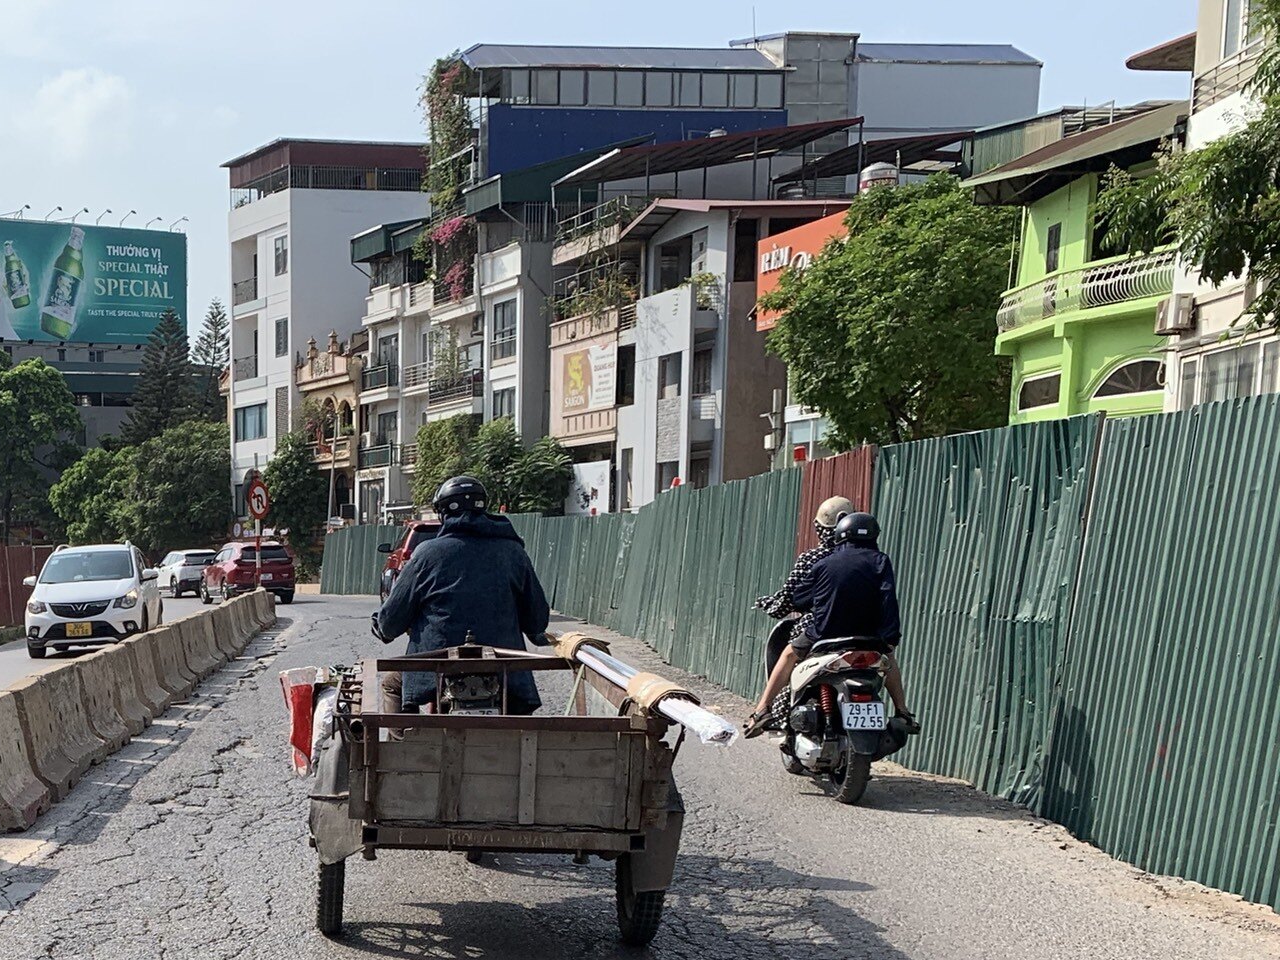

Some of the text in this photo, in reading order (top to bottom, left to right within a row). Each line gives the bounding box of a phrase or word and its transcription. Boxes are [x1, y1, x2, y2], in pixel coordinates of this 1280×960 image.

[151, 248, 161, 261] VỊ
[761, 243, 792, 273] RÈM
[99, 261, 169, 278] SPECIAL THẬT
[94, 278, 174, 299] SPECIAL
[88, 309, 104, 317] TASTE
[117, 310, 140, 318] SPECIAL
[141, 311, 158, 319] TRULY
[849, 704, 879, 716] 29-F1
[846, 716, 884, 728] 472.55
